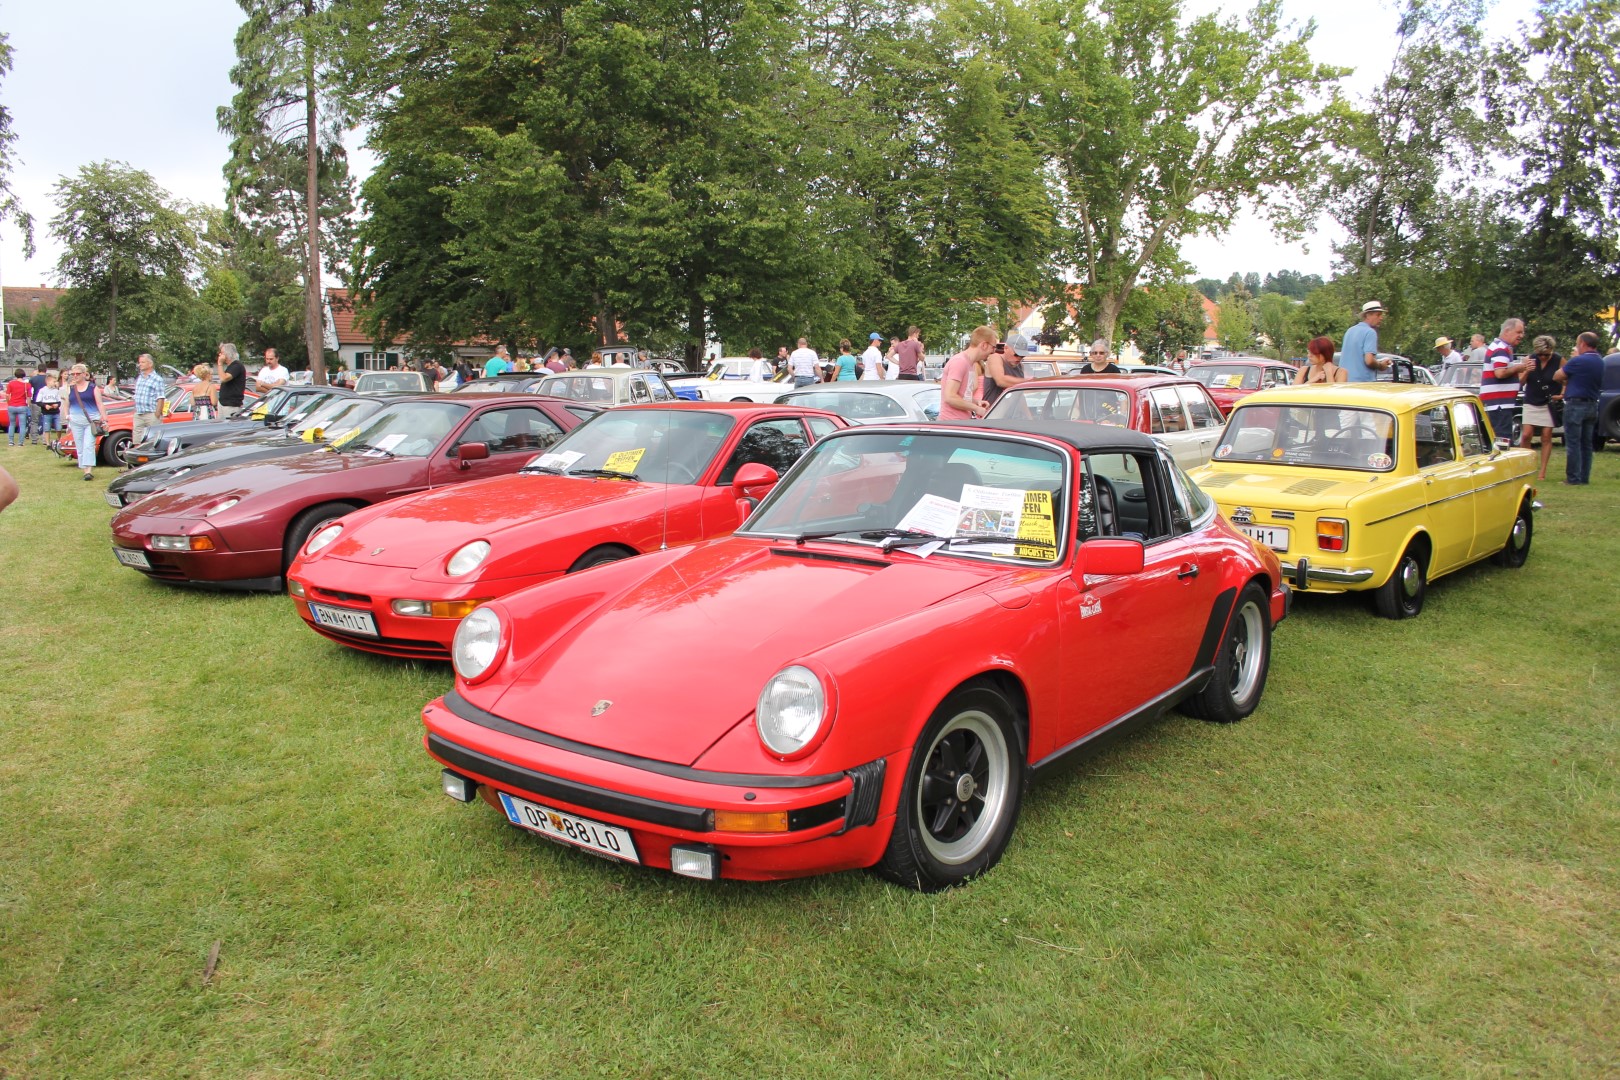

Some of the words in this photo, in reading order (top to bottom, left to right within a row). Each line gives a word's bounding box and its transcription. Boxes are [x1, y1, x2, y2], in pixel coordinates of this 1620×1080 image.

[1101, 402, 1117, 415] OPEL
[1019, 547, 1043, 558] AUGUST
[319, 609, 333, 624] BN
[339, 614, 368, 630] 411LT
[525, 806, 547, 829] OP
